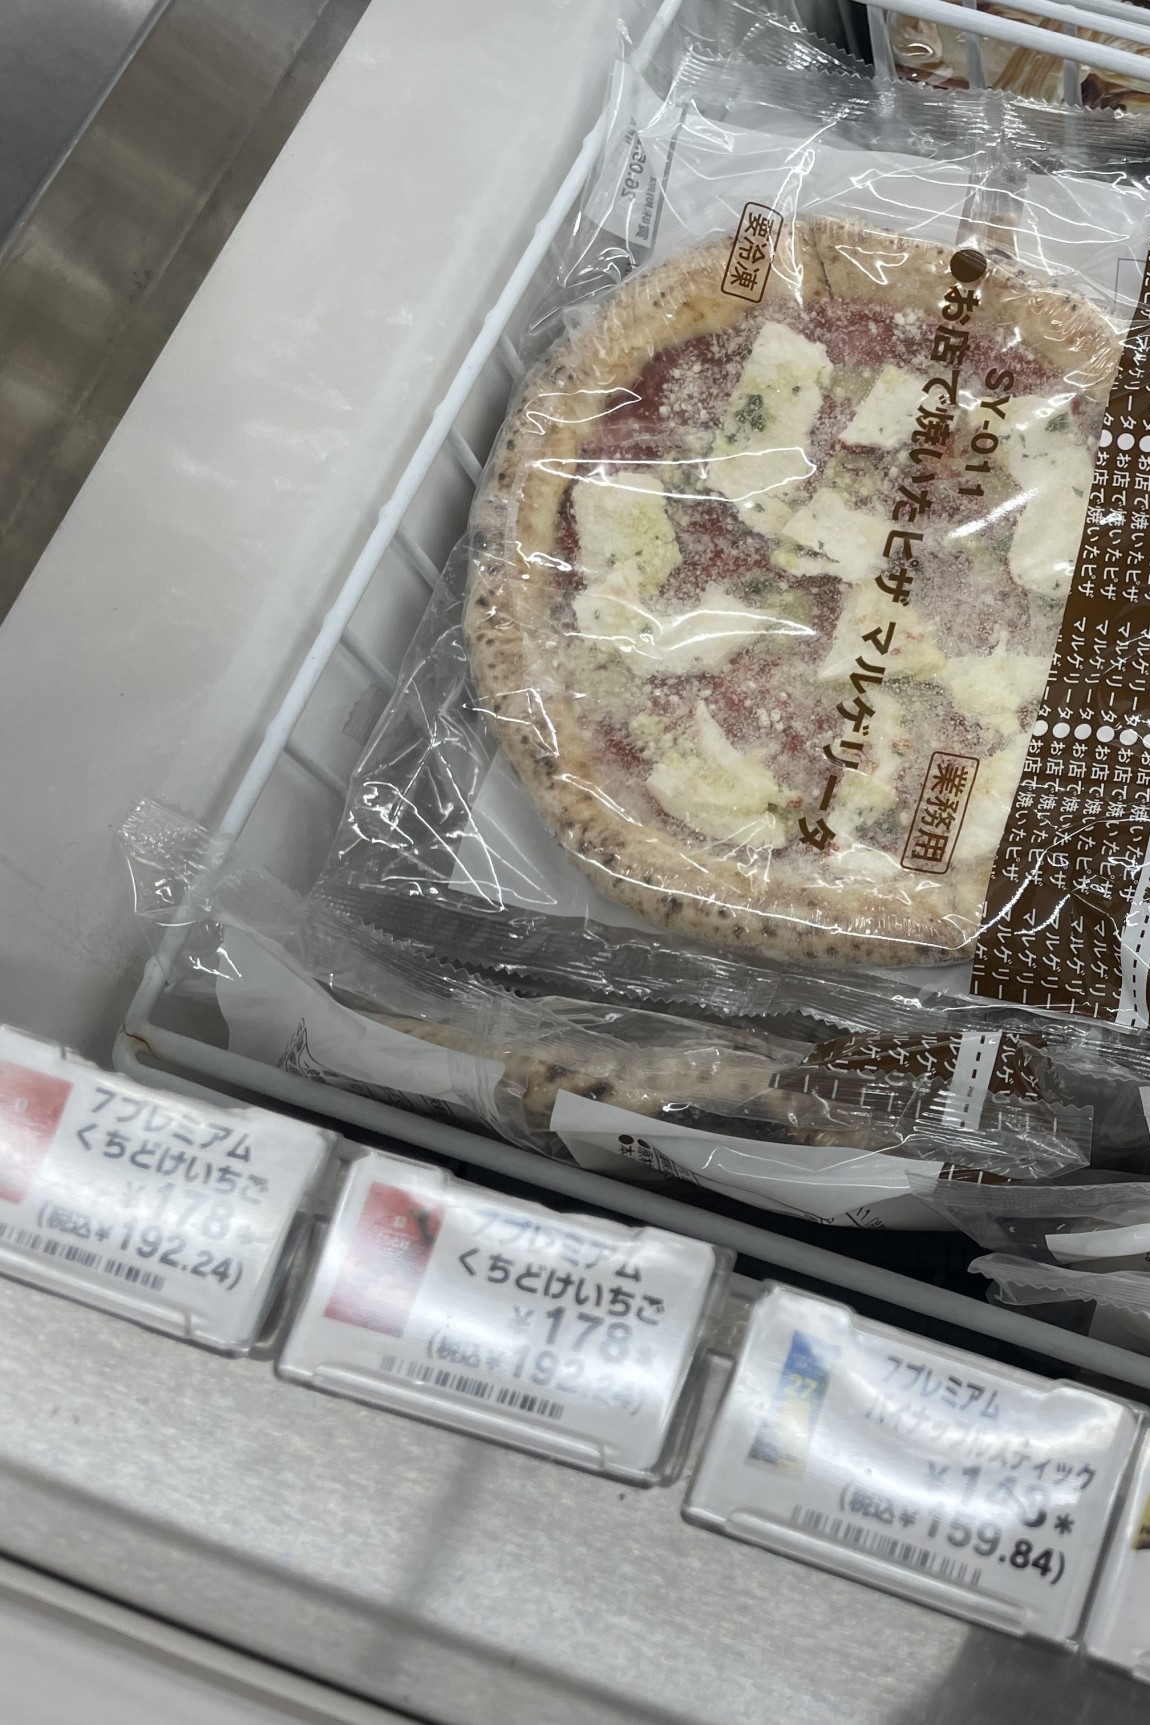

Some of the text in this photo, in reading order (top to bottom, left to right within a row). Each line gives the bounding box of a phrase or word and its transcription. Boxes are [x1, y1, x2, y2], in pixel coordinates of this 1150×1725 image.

[729, 209, 779, 292] 要冷凍
[959, 368, 1014, 497] SY-011
[798, 286, 979, 852] お店で焼いたピザ マルゲリータ
[911, 759, 970, 866] 業務用
[1066, 916, 1086, 1013] マルゲリー
[1089, 920, 1109, 1018] マルゲリー
[76, 1123, 271, 1205] くちどけいちご
[458, 1248, 666, 1326] くちどけいちご
